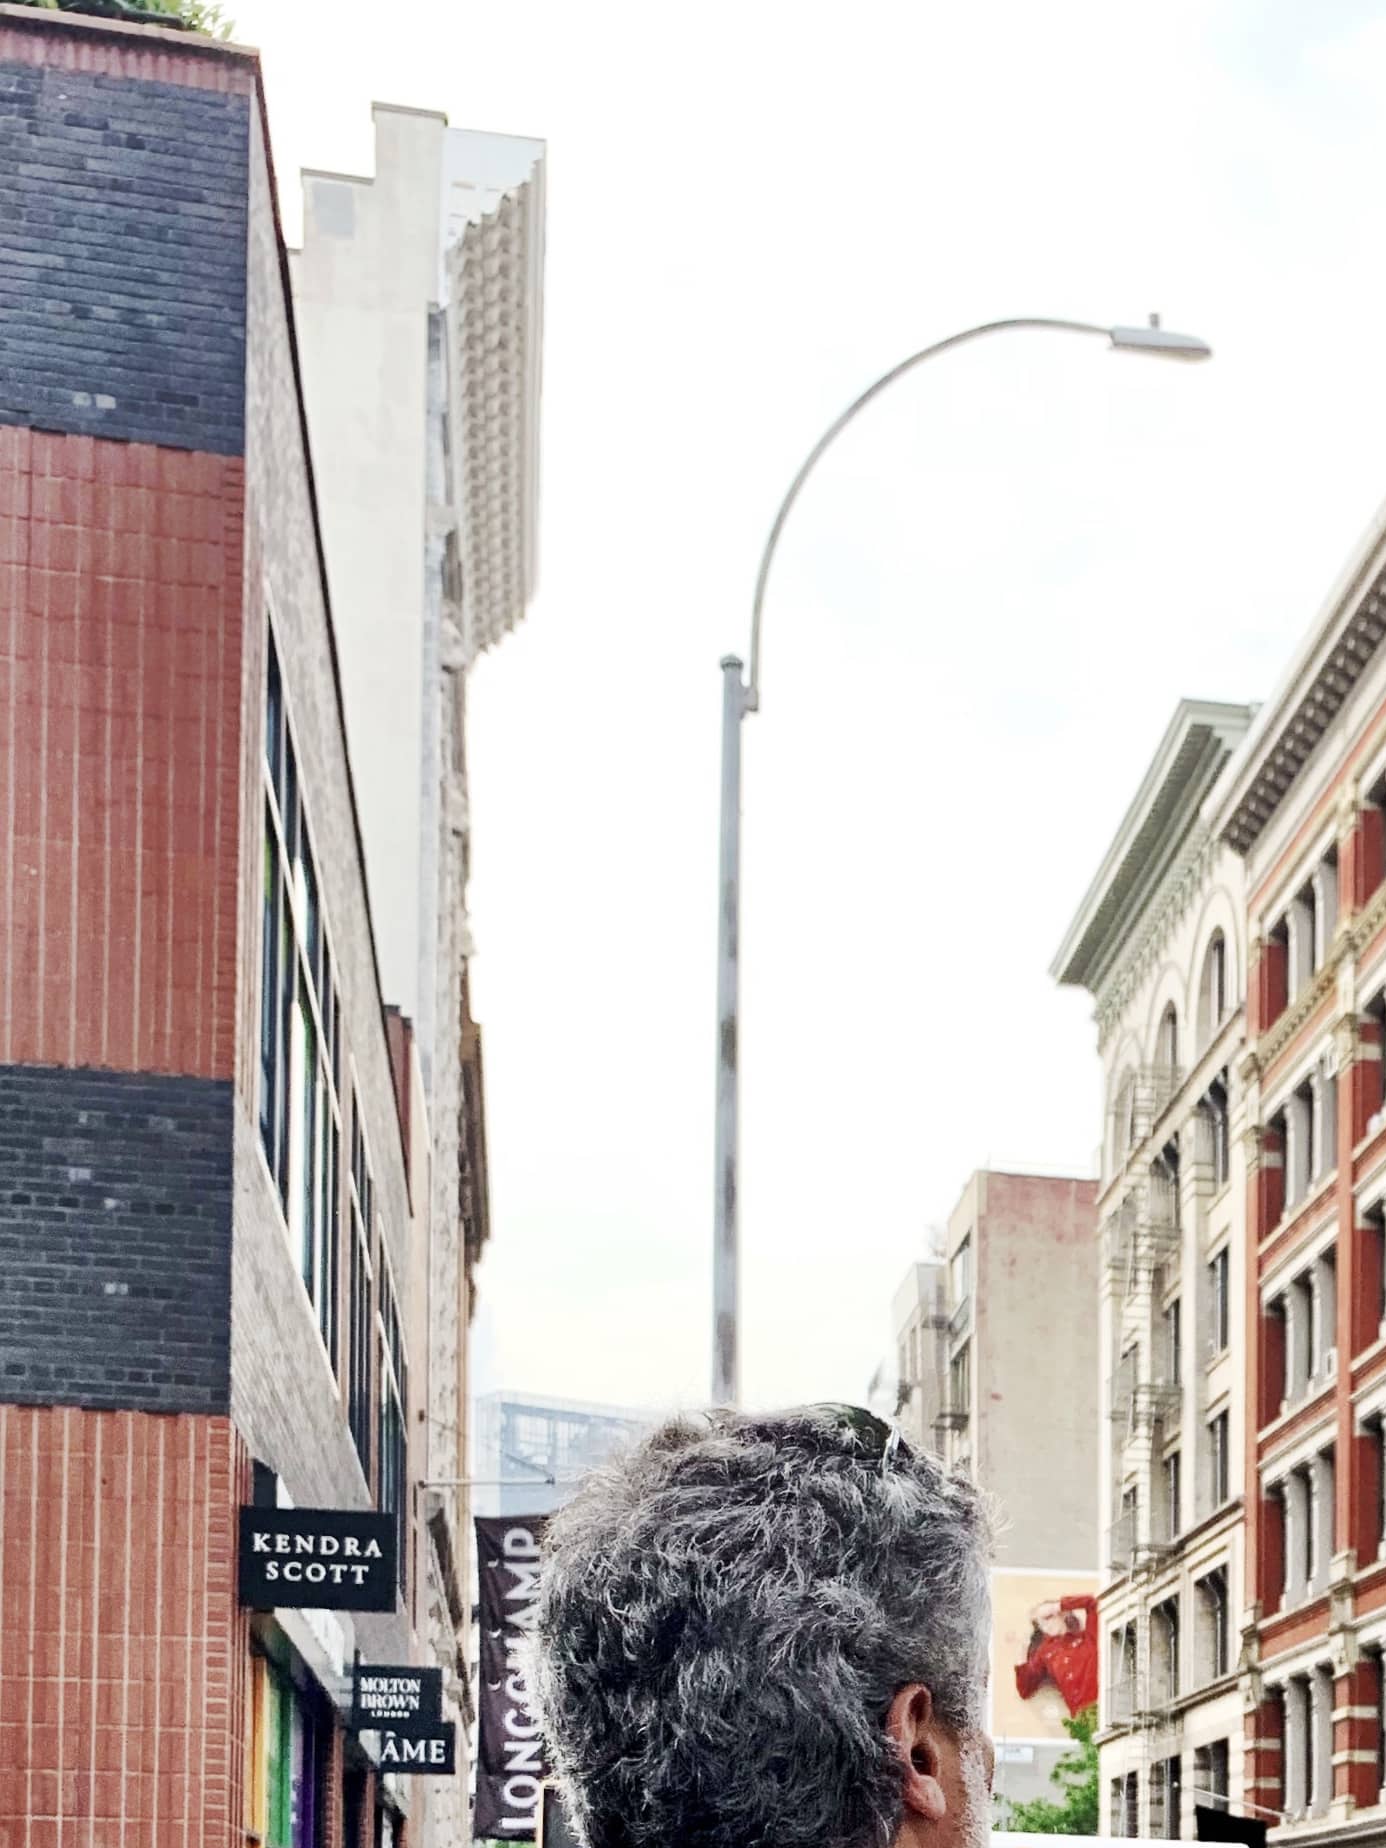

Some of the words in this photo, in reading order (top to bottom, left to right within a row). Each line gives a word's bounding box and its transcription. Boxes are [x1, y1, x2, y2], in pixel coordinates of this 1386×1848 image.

[252, 1532, 383, 1558] KENDRA
[266, 1560, 370, 1584] SCOTT
[360, 1677, 421, 1693] MOLTON
[360, 1694, 420, 1710] BROWN
